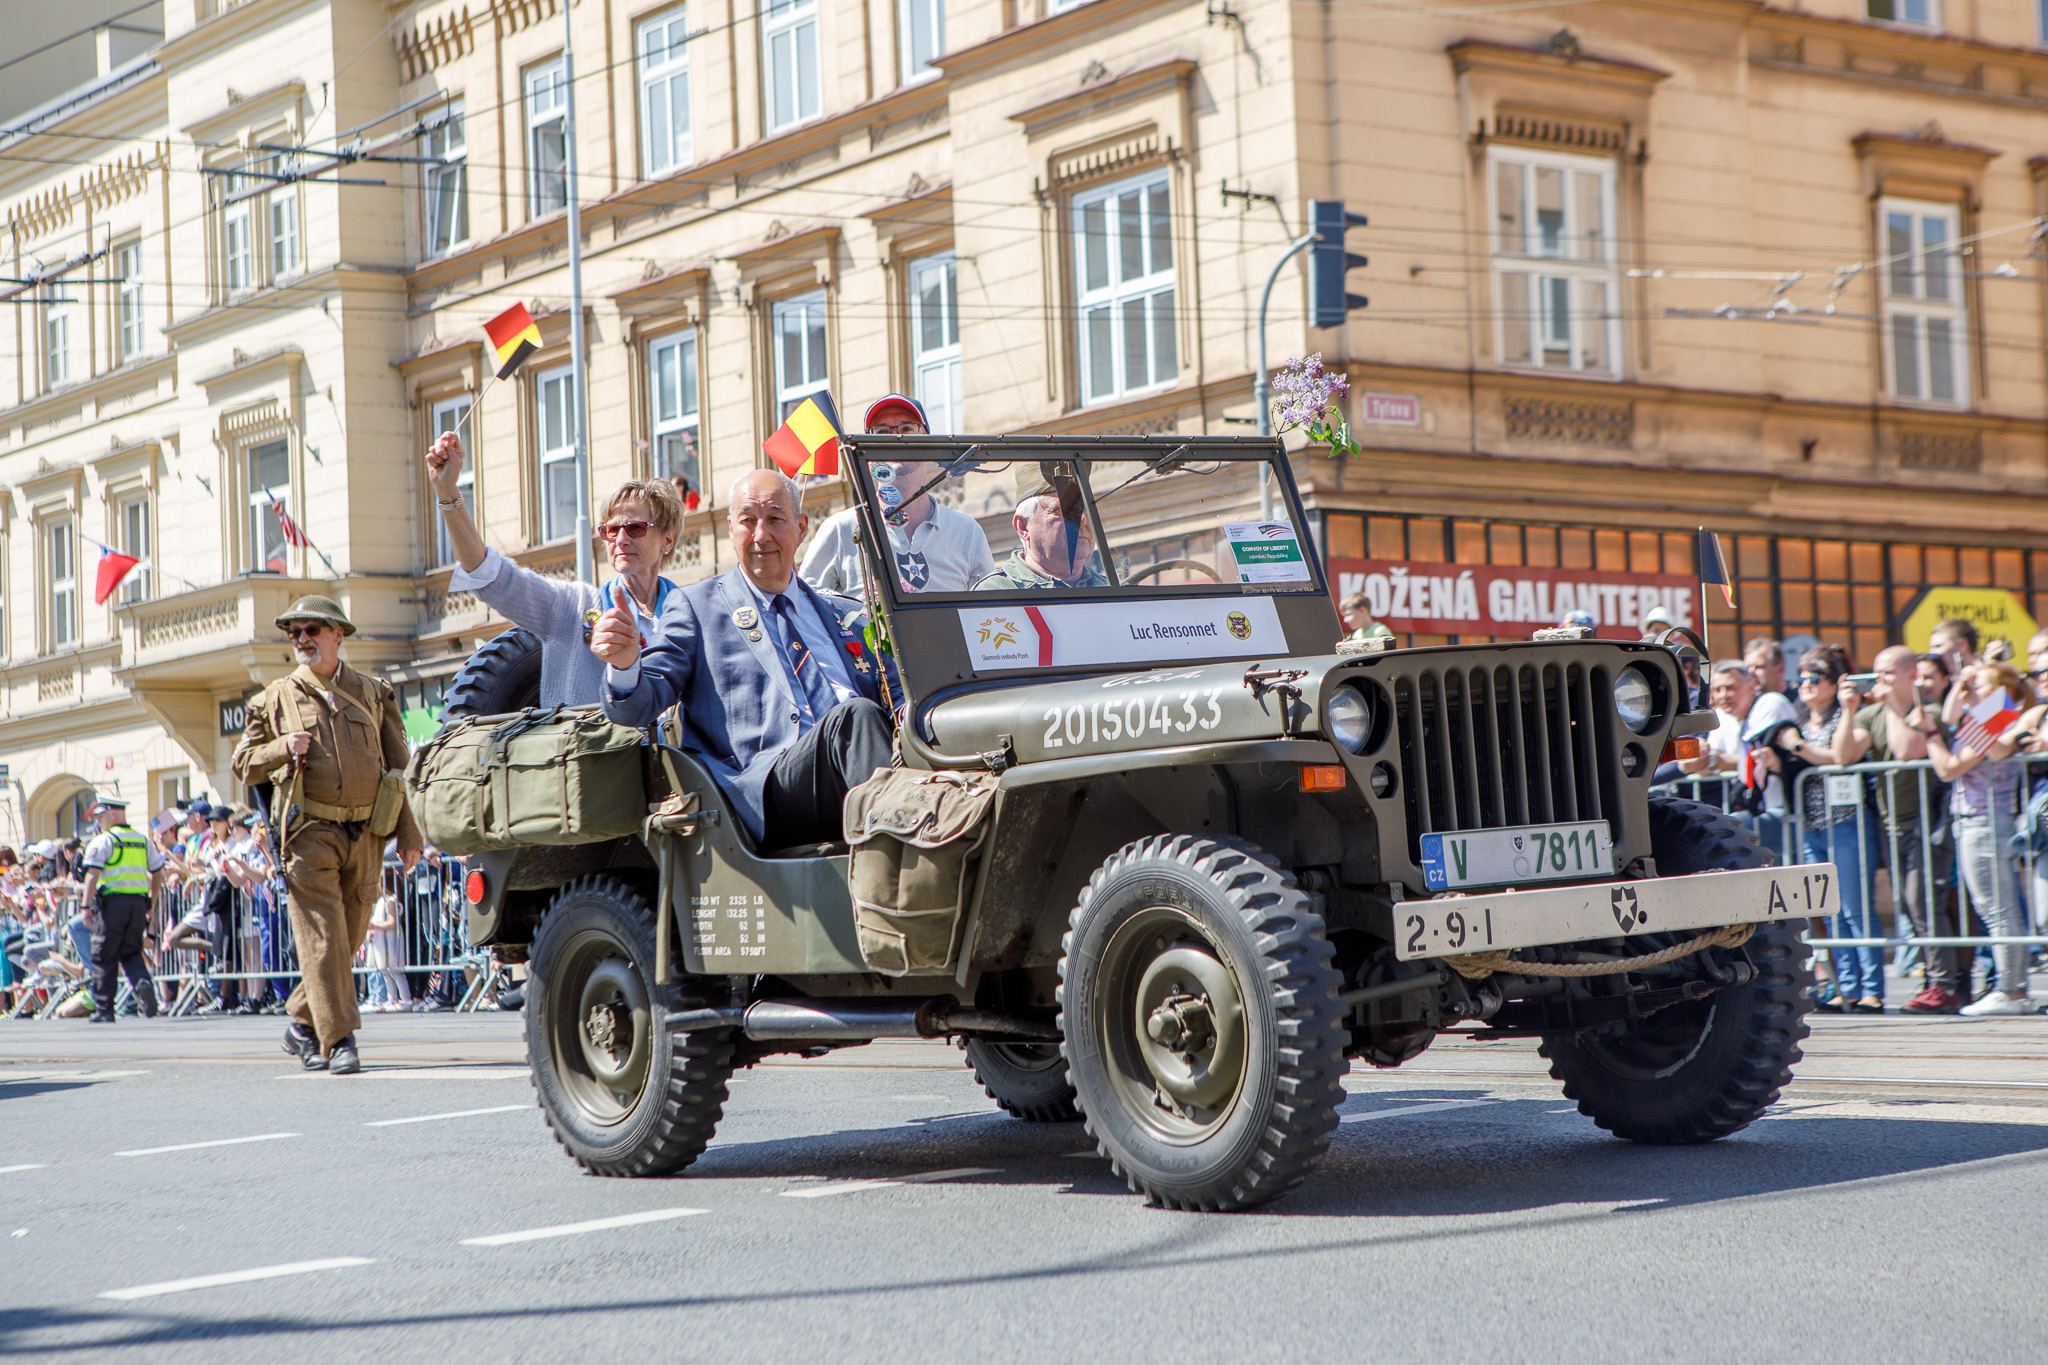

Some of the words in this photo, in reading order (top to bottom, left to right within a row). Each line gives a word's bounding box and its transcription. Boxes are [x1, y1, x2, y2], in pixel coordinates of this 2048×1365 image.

[1338, 566, 1480, 620] KOŽENÁ
[1488, 579, 1693, 631] GALANTERIE
[1129, 624, 1152, 640] Luc
[1152, 622, 1218, 639] Rensonnet
[223, 705, 248, 731] NO
[1043, 687, 1223, 748] 20150433
[1451, 839, 1467, 880] V
[1530, 829, 1599, 873] 7811
[1429, 869, 1445, 882] CZ
[691, 896, 709, 906] ROAD
[709, 896, 720, 906] WT
[753, 895, 764, 906] LB
[1142, 885, 1194, 910] FORD
[756, 908, 765, 918] IN
[756, 920, 765, 931] IN
[740, 933, 749, 944] 52
[757, 933, 766, 944] IN
[693, 946, 713, 956] FLOOR
[714, 946, 732, 956] AREA
